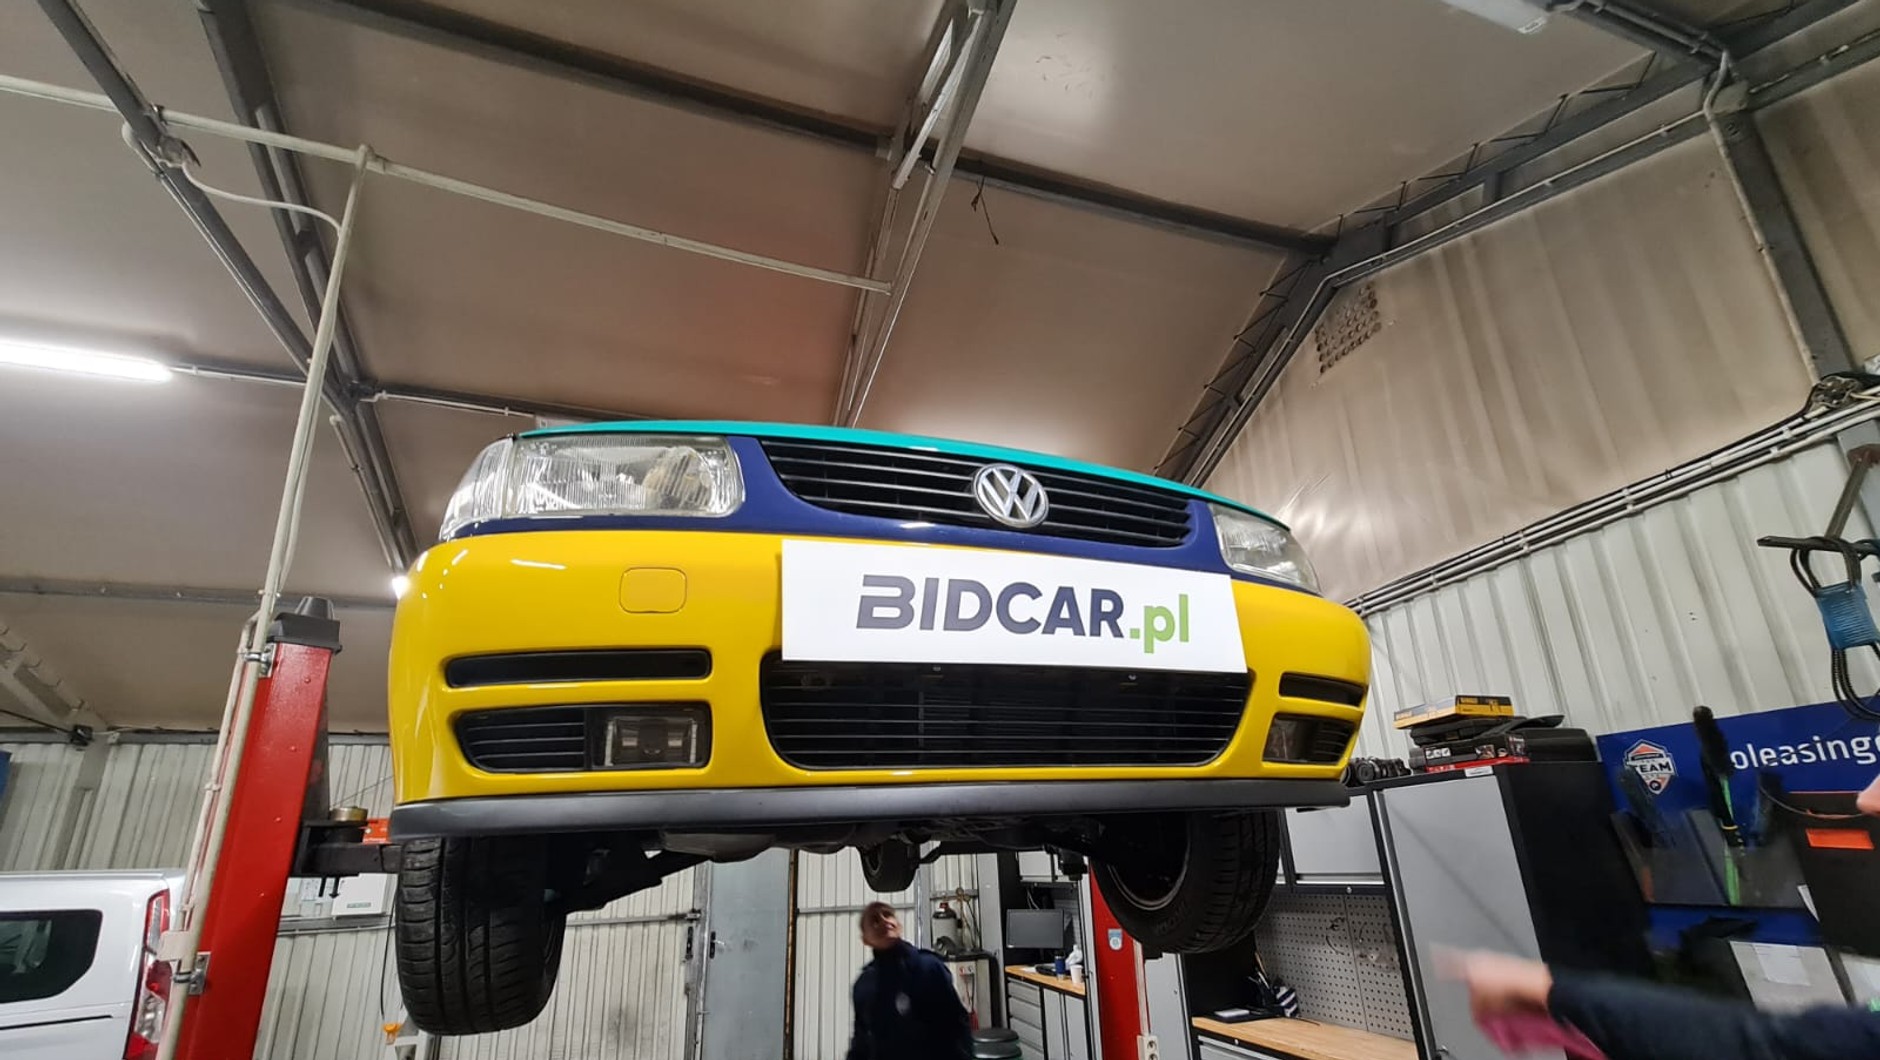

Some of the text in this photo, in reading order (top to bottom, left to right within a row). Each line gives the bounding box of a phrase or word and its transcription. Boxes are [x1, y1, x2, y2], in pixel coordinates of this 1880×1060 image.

[979, 466, 1043, 524] VW
[856, 573, 1190, 654] BIDCAR.pl
[1730, 735, 1880, 770] oleasing
